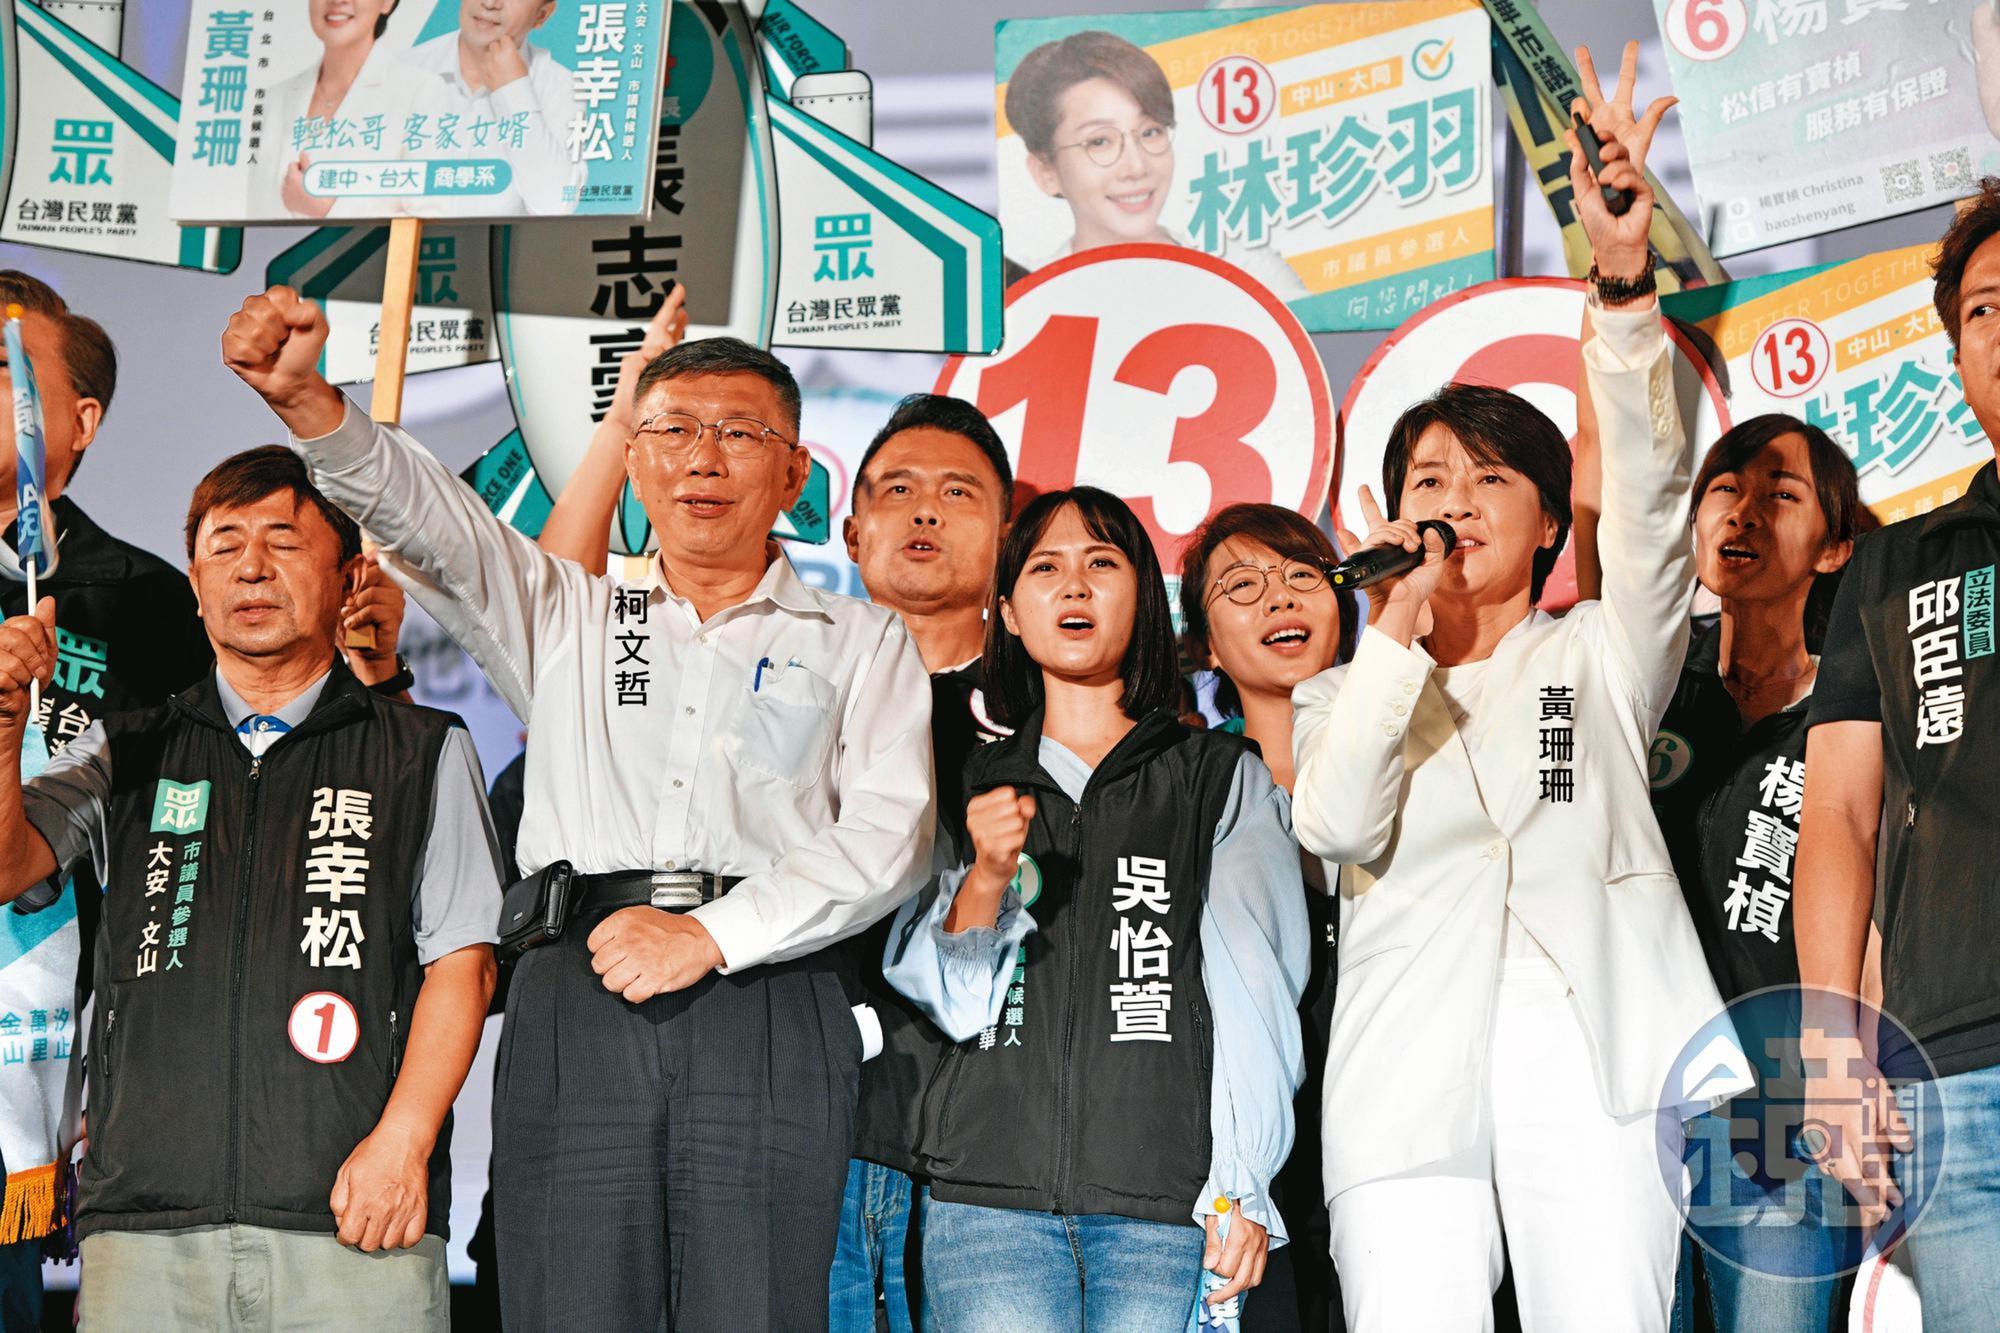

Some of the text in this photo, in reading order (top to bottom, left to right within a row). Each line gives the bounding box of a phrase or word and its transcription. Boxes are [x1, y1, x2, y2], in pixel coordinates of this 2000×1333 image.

[256, 9, 275, 69] 台北市
[765, 10, 788, 37] AIR
[784, 30, 820, 72] FORCE
[1269, 8, 1398, 51] TOGETHER
[1685, 0, 1730, 52] 6
[192, 10, 254, 167] 黃珊珊
[567, 3, 627, 163] 張幸松
[1212, 66, 1261, 125] 13
[1720, 51, 1863, 125] 松信有寶楨
[1805, 66, 1949, 142] 服務有保證
[49, 118, 113, 186] 眾
[291, 110, 530, 152] 輕松哥 客家女婿
[1187, 86, 1477, 253] 林珍羽
[1802, 173, 1864, 198] Christina
[17, 223, 56, 233] TAIWAN
[106, 227, 137, 237] PARTY
[18, 198, 138, 225] 台灣民眾黨
[1764, 201, 1857, 232] baozhenyang
[814, 213, 874, 282] 眾
[1322, 226, 1470, 279] 市議員參選人
[787, 294, 901, 324] 台灣民眾黨
[787, 325, 825, 335] TAIWAN
[872, 318, 901, 328] PARTY
[1723, 250, 1936, 349] BETTER TOGETHE
[1764, 327, 1815, 391] 13
[501, 449, 525, 478] ONE
[972, 314, 1278, 574] 13
[800, 499, 823, 529] ONE
[1966, 570, 1992, 657] 立法委員
[1907, 576, 1965, 750] 邱臣遠
[1649, 736, 1677, 782] 6
[160, 787, 200, 828] 眾
[165, 841, 202, 971] 市議員參選人
[300, 787, 373, 970] 張幸松
[1110, 856, 1173, 1042] 吳怡萱
[314, 1002, 336, 1054] 1
